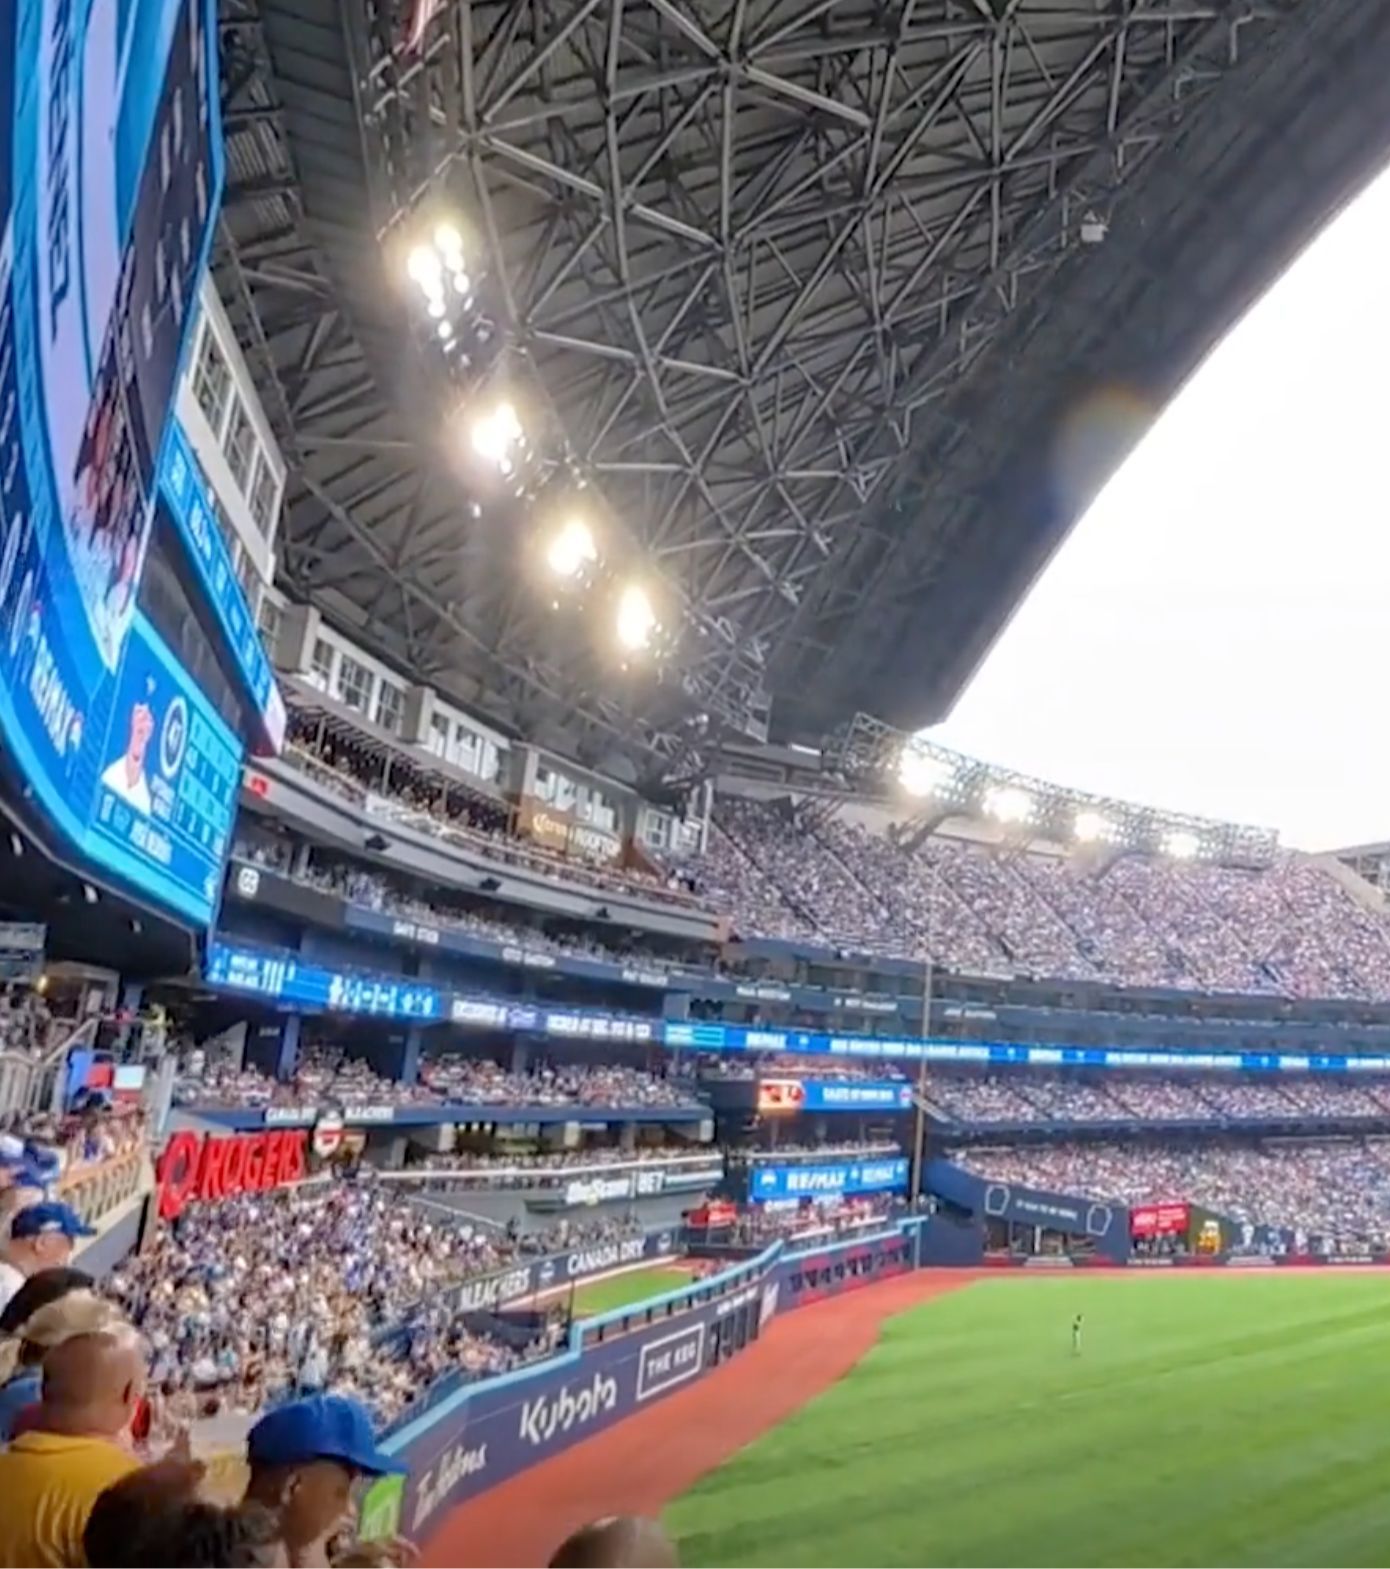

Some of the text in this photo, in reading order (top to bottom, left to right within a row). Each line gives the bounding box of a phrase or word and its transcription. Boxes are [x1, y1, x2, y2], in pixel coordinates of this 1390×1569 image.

[201, 1129, 307, 1201] ROGERS
[787, 1169, 847, 1190] RE/MAX
[568, 1242, 619, 1273] CANADA
[648, 1346, 697, 1380] THE KEG
[519, 1372, 618, 1444] Kubota
